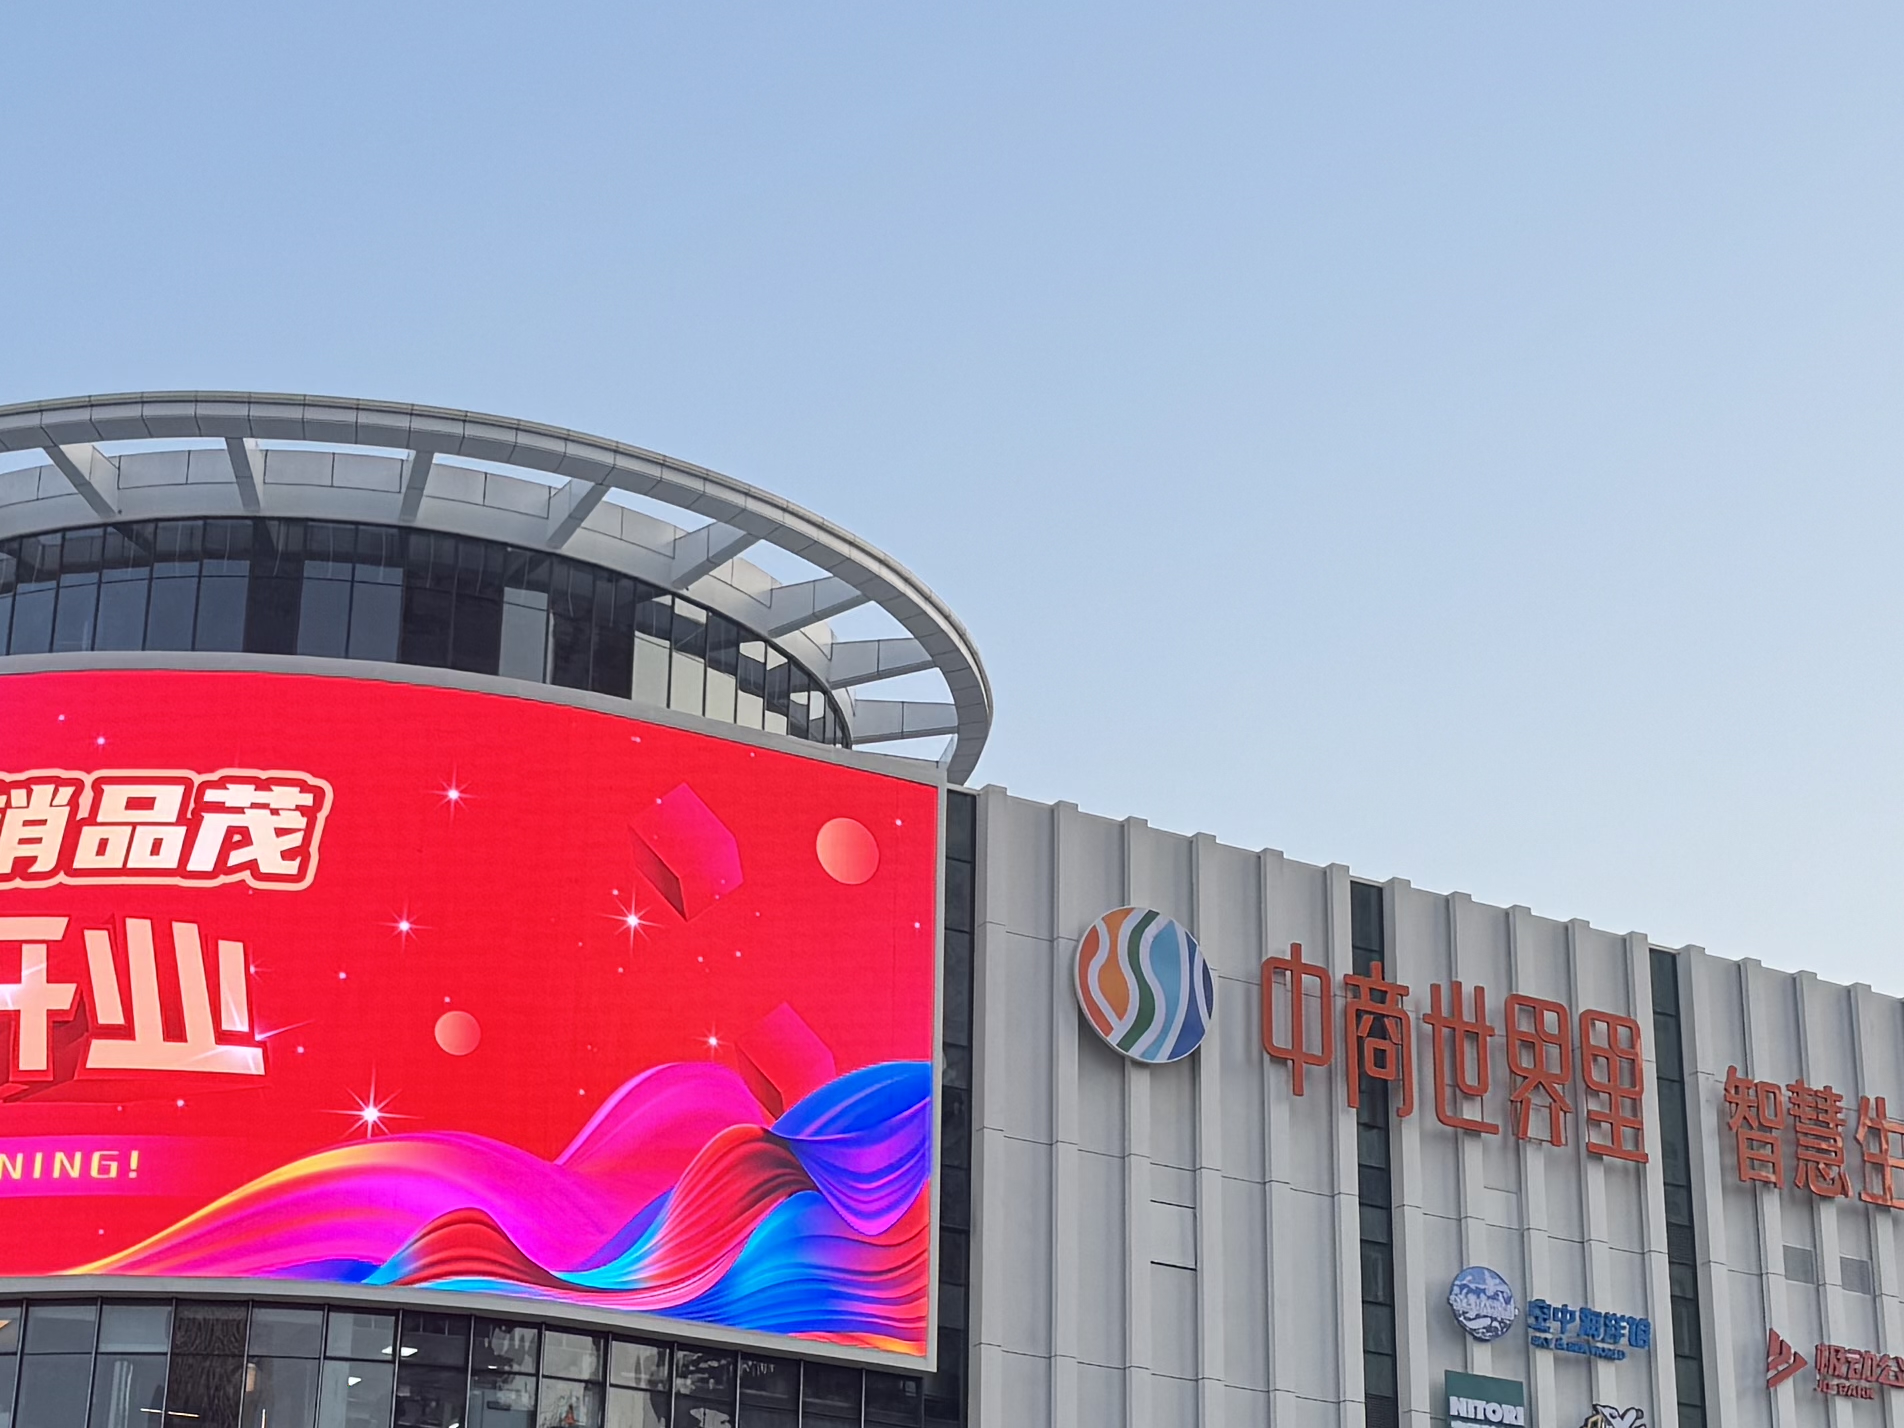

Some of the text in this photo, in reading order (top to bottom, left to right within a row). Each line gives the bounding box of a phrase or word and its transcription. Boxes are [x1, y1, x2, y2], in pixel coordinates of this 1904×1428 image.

[1261, 942, 1649, 1164] 中商世界里
[1449, 1396, 1525, 1427] NITORI
